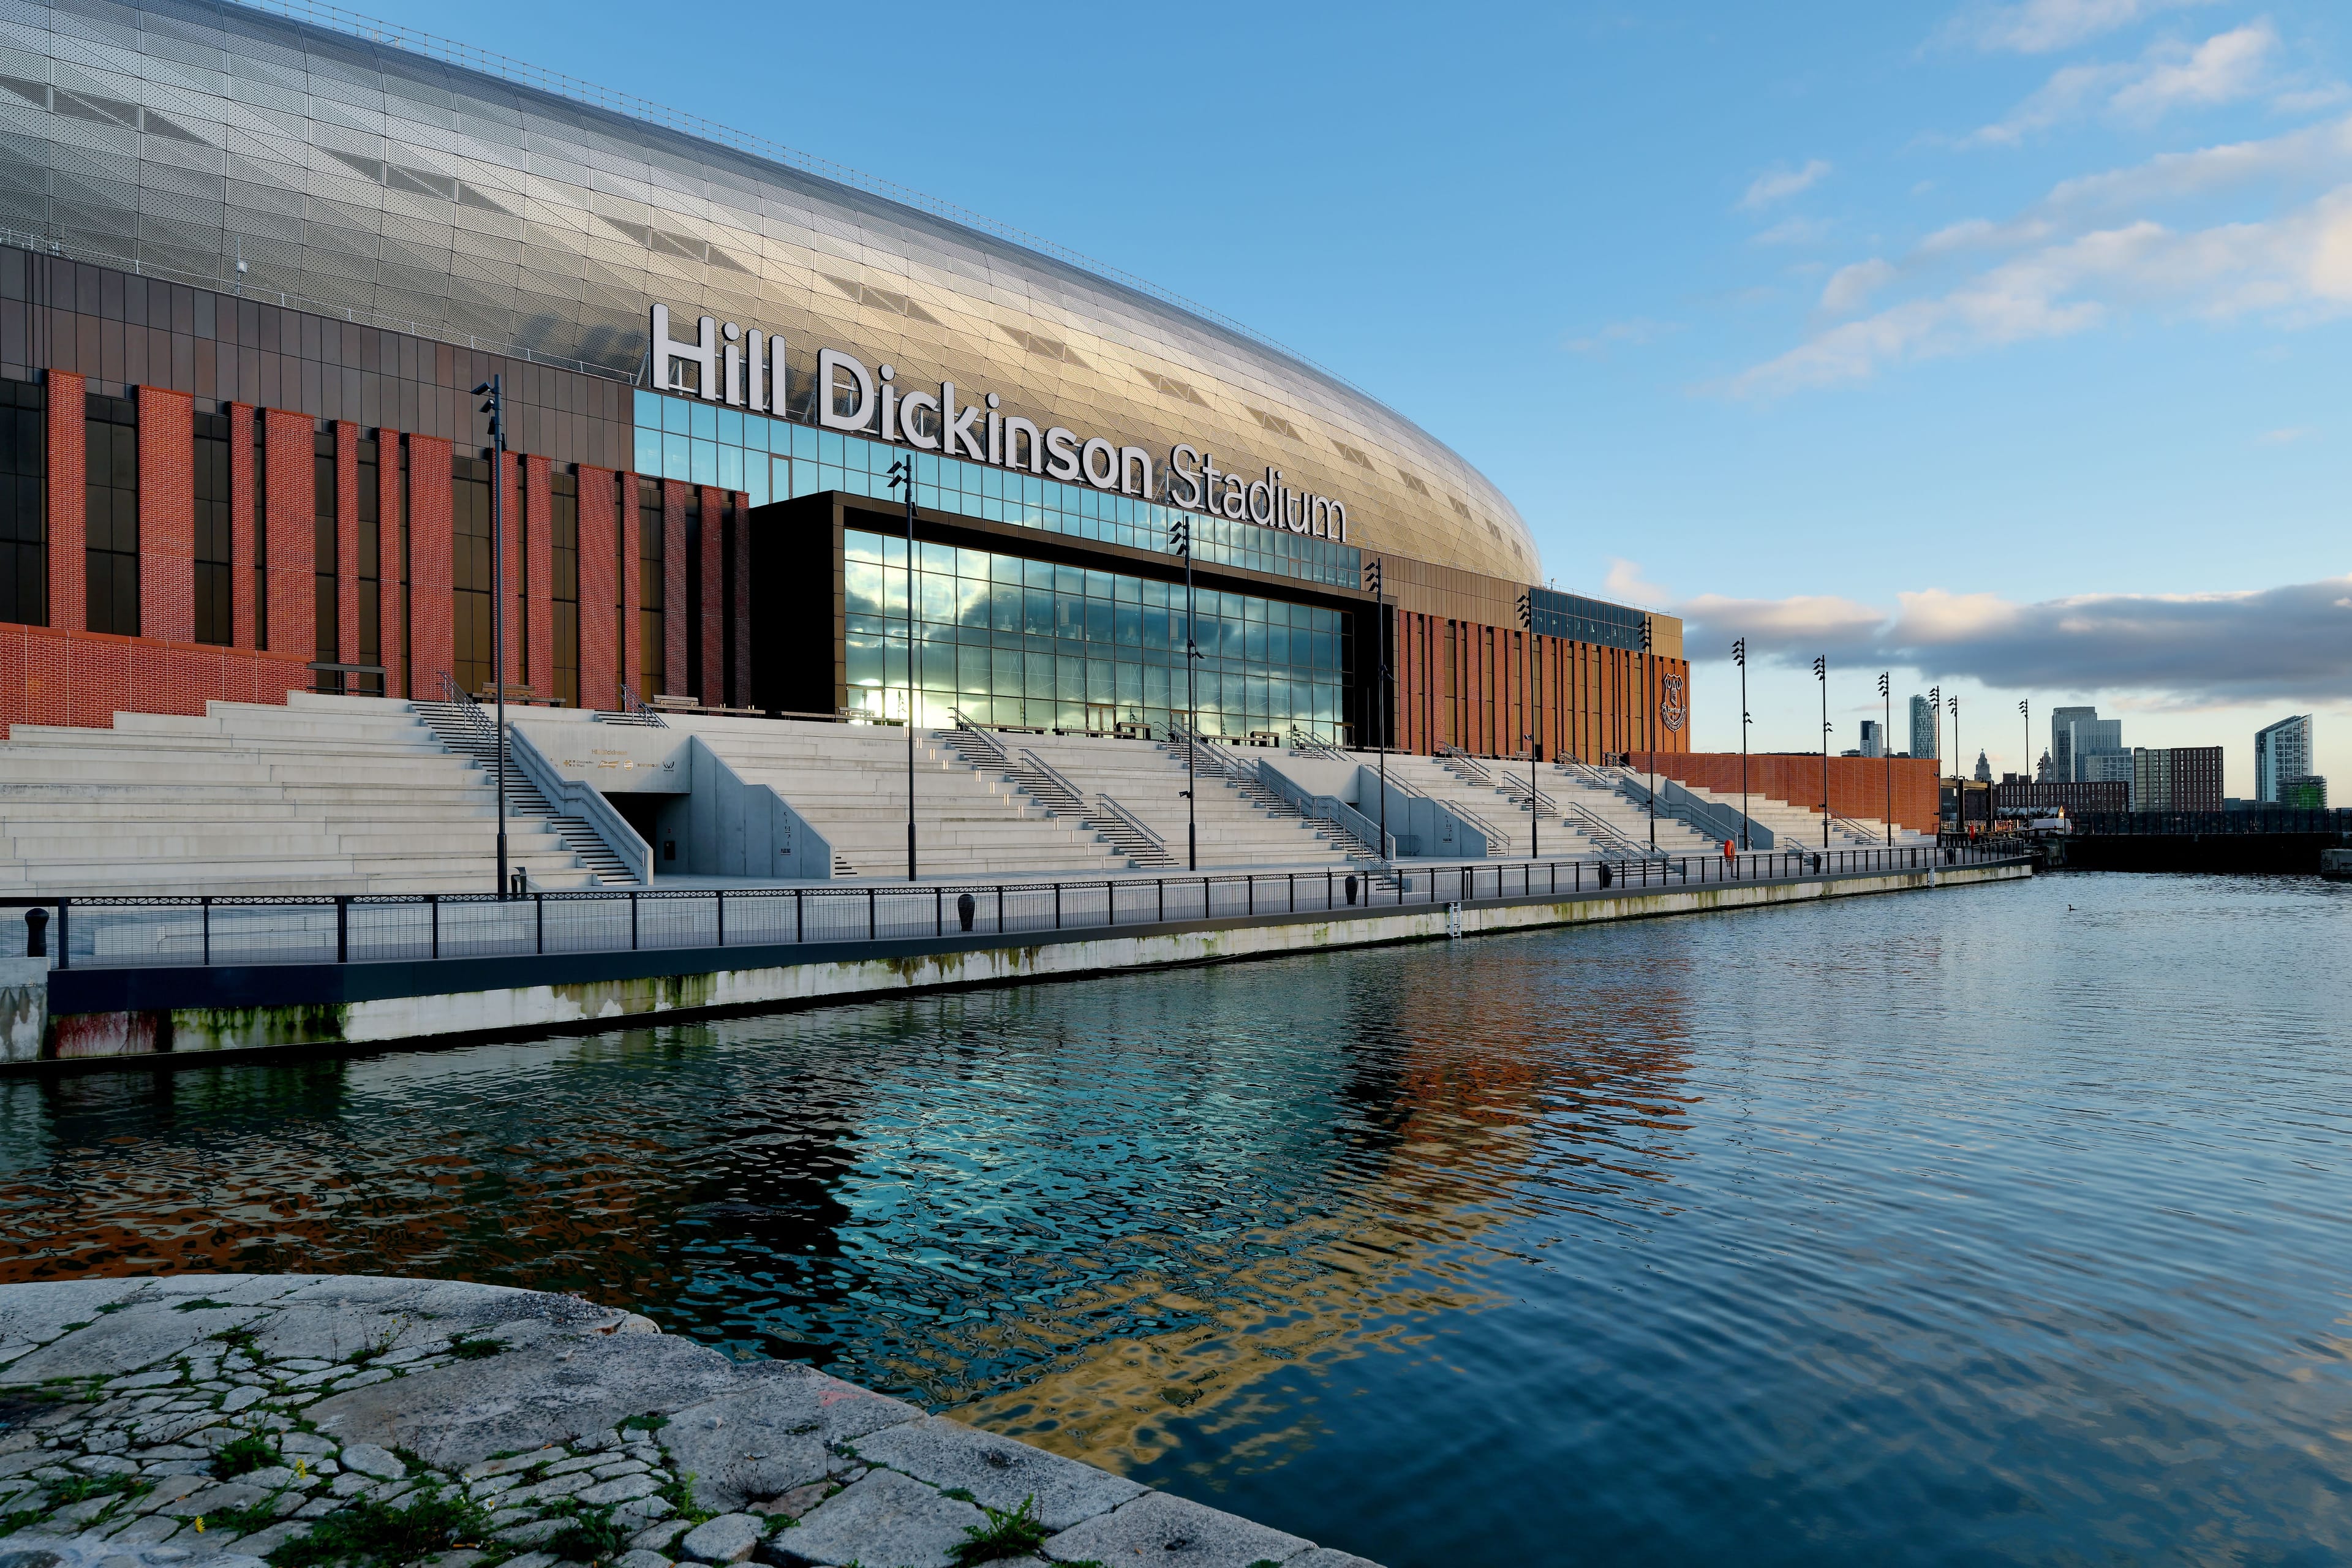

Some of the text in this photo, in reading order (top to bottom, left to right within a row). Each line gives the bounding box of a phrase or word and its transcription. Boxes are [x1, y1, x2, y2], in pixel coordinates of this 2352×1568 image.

[650, 303, 1347, 543] Hill Dickinson Stadium
